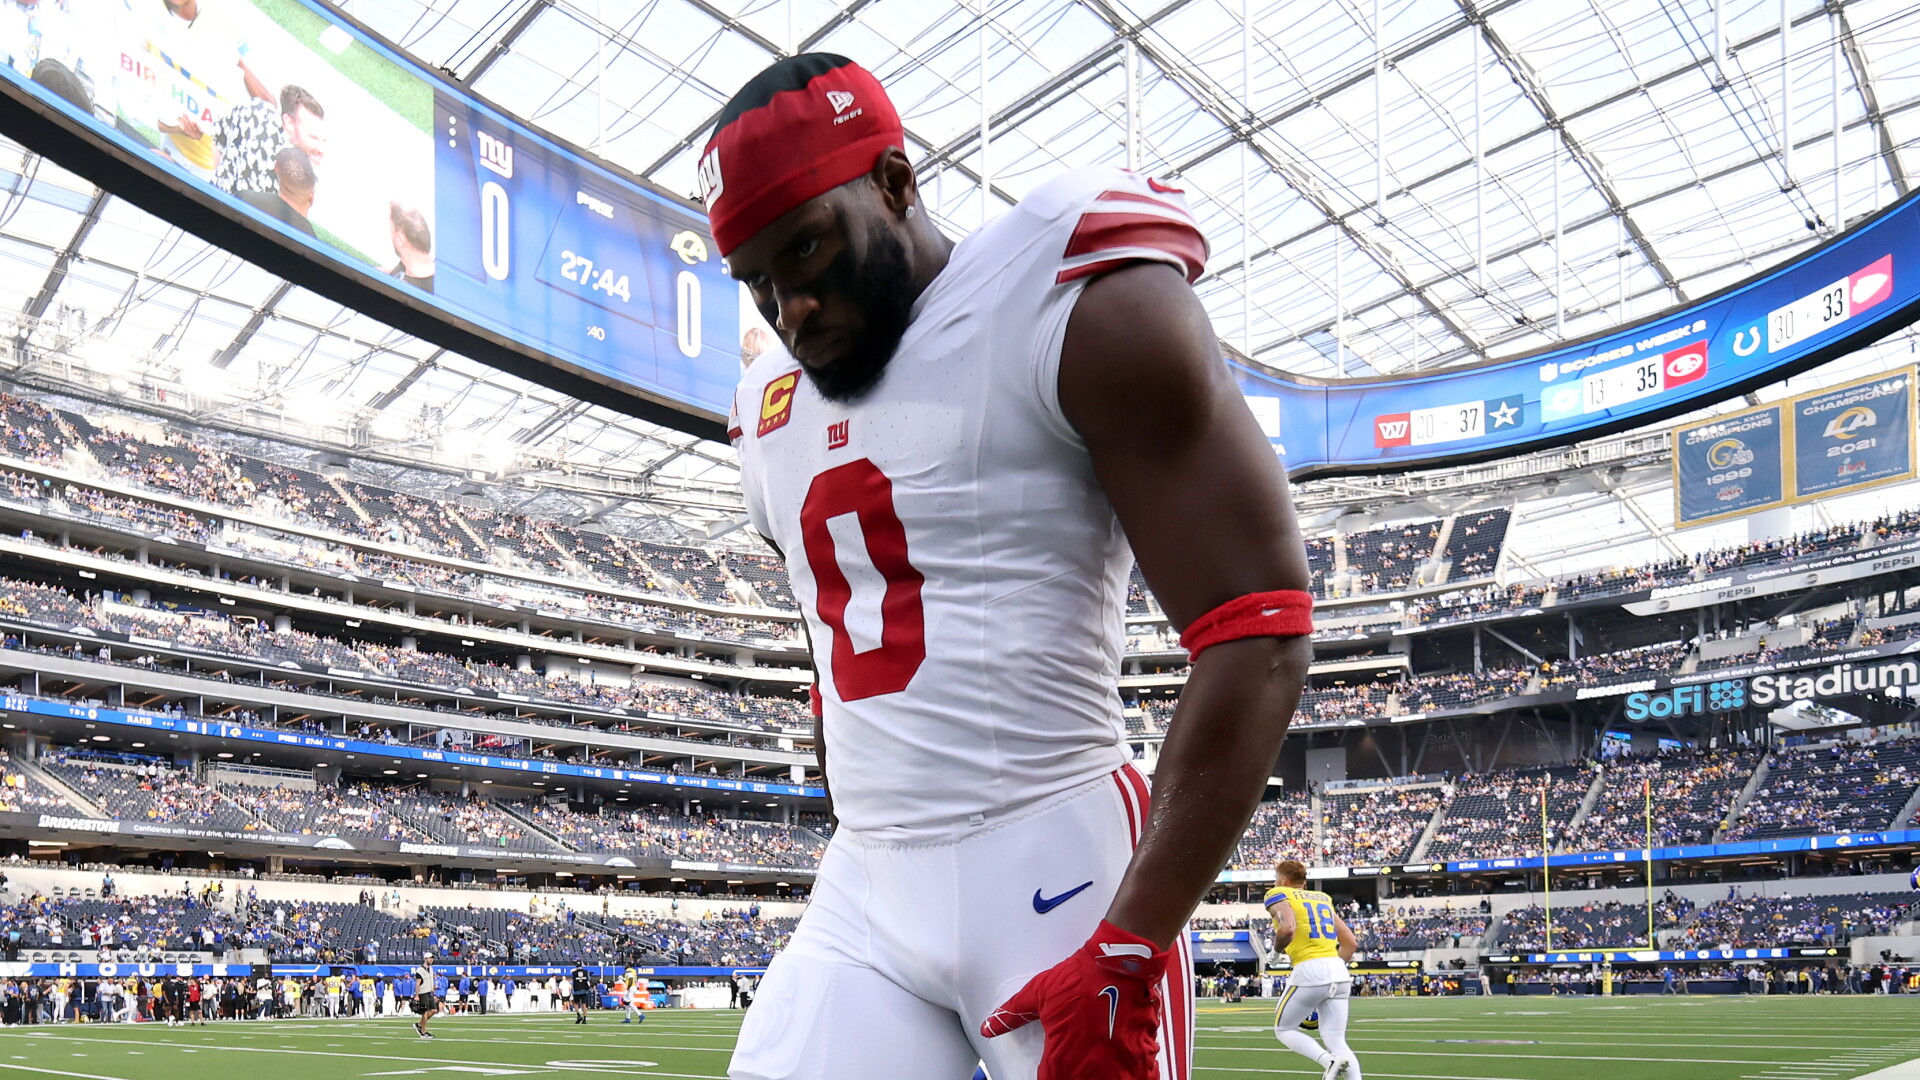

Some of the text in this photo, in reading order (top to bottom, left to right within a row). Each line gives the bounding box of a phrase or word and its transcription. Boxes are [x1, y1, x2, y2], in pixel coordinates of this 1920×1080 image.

[481, 181, 510, 281] 0
[560, 250, 630, 303] 27:44
[676, 270, 702, 358] 0
[1774, 311, 1794, 343] 30
[1822, 287, 1845, 323] 33
[1560, 345, 1634, 375] SCORES
[1636, 328, 1690, 353] WEEK
[761, 374, 796, 419] C
[1588, 378, 1604, 406] 13
[1636, 363, 1658, 392] 35
[1459, 408, 1479, 433] 37
[1685, 417, 1773, 446] CHAMPIONS
[1826, 438, 1877, 458] 2021
[1706, 467, 1753, 486] 1999
[1746, 565, 1790, 580] Confidence
[1791, 562, 1809, 574] with
[1809, 560, 1831, 573] every
[1832, 553, 1854, 567] drive,
[1856, 548, 1879, 561] that's
[1880, 544, 1902, 557] what
[1873, 556, 1916, 572] PEPSI
[800, 457, 926, 703] 0
[1718, 586, 1756, 600] PEPSI
[1670, 648, 1879, 685] Confidence with every drive, that's what really matters.
[1626, 660, 1920, 721] SoFi Stadium
[126, 714, 152, 726] RAMS
[305, 737, 324, 746] 27:44
[422, 751, 443, 760] RAMS
[38, 814, 121, 833] BRIDGESTONE
[133, 825, 301, 843] Confidence with every drive, that's what really matters.
[468, 848, 496, 856] Confidence
[1303, 901, 1338, 940] 18
